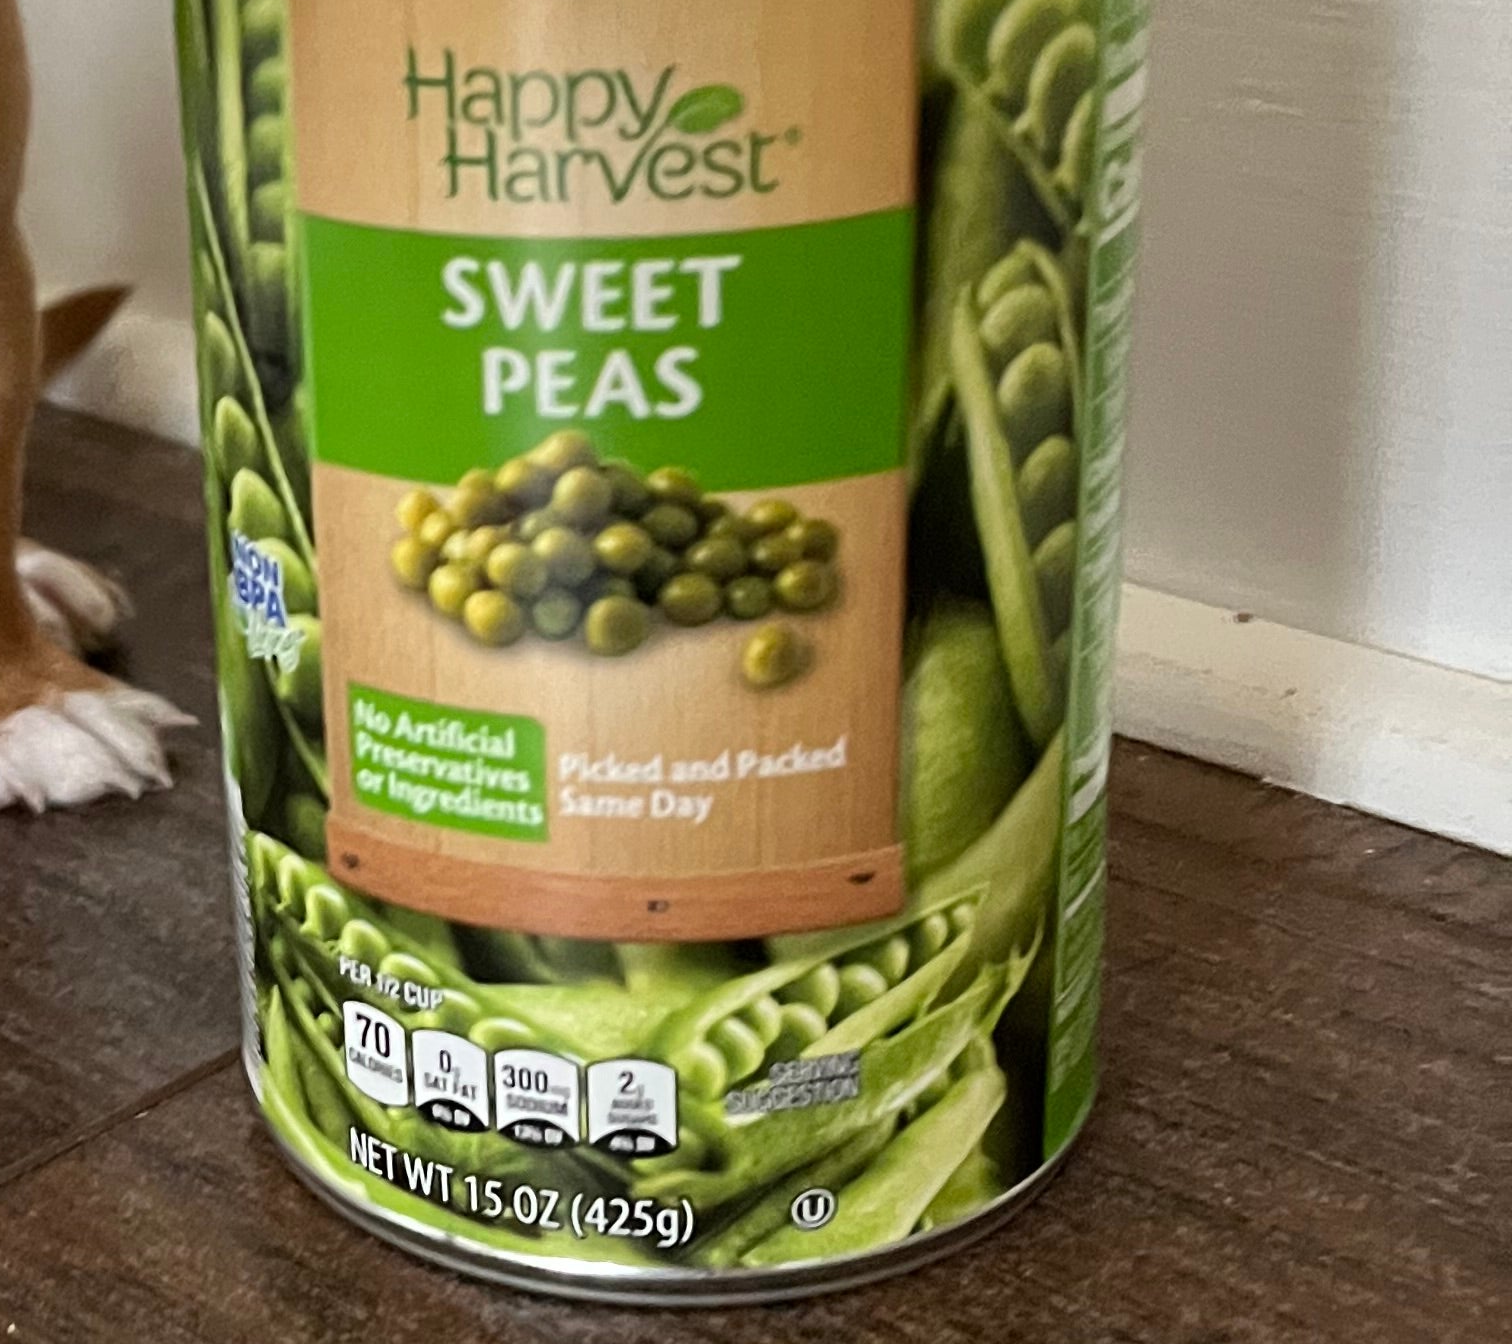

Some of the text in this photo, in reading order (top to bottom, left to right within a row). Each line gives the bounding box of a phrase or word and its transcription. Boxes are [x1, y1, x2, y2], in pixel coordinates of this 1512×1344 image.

[404, 44, 678, 142] Happy
[444, 120, 781, 205] Harvest
[441, 254, 744, 333] SWEET
[481, 346, 704, 420] PEAS
[231, 532, 280, 587] NON
[235, 568, 287, 629] BPA
[353, 698, 516, 759] No Artificial
[559, 733, 847, 783] Picked and Packed
[355, 729, 532, 793] Preservatives
[356, 767, 544, 827] or Ingredients
[559, 785, 714, 826] Same Day
[340, 955, 372, 988] PER
[404, 981, 445, 1010] CUP
[355, 1011, 391, 1059] 70
[501, 1063, 571, 1100] 300
[350, 1127, 694, 1249] NET WT 15 OZ (425g)
